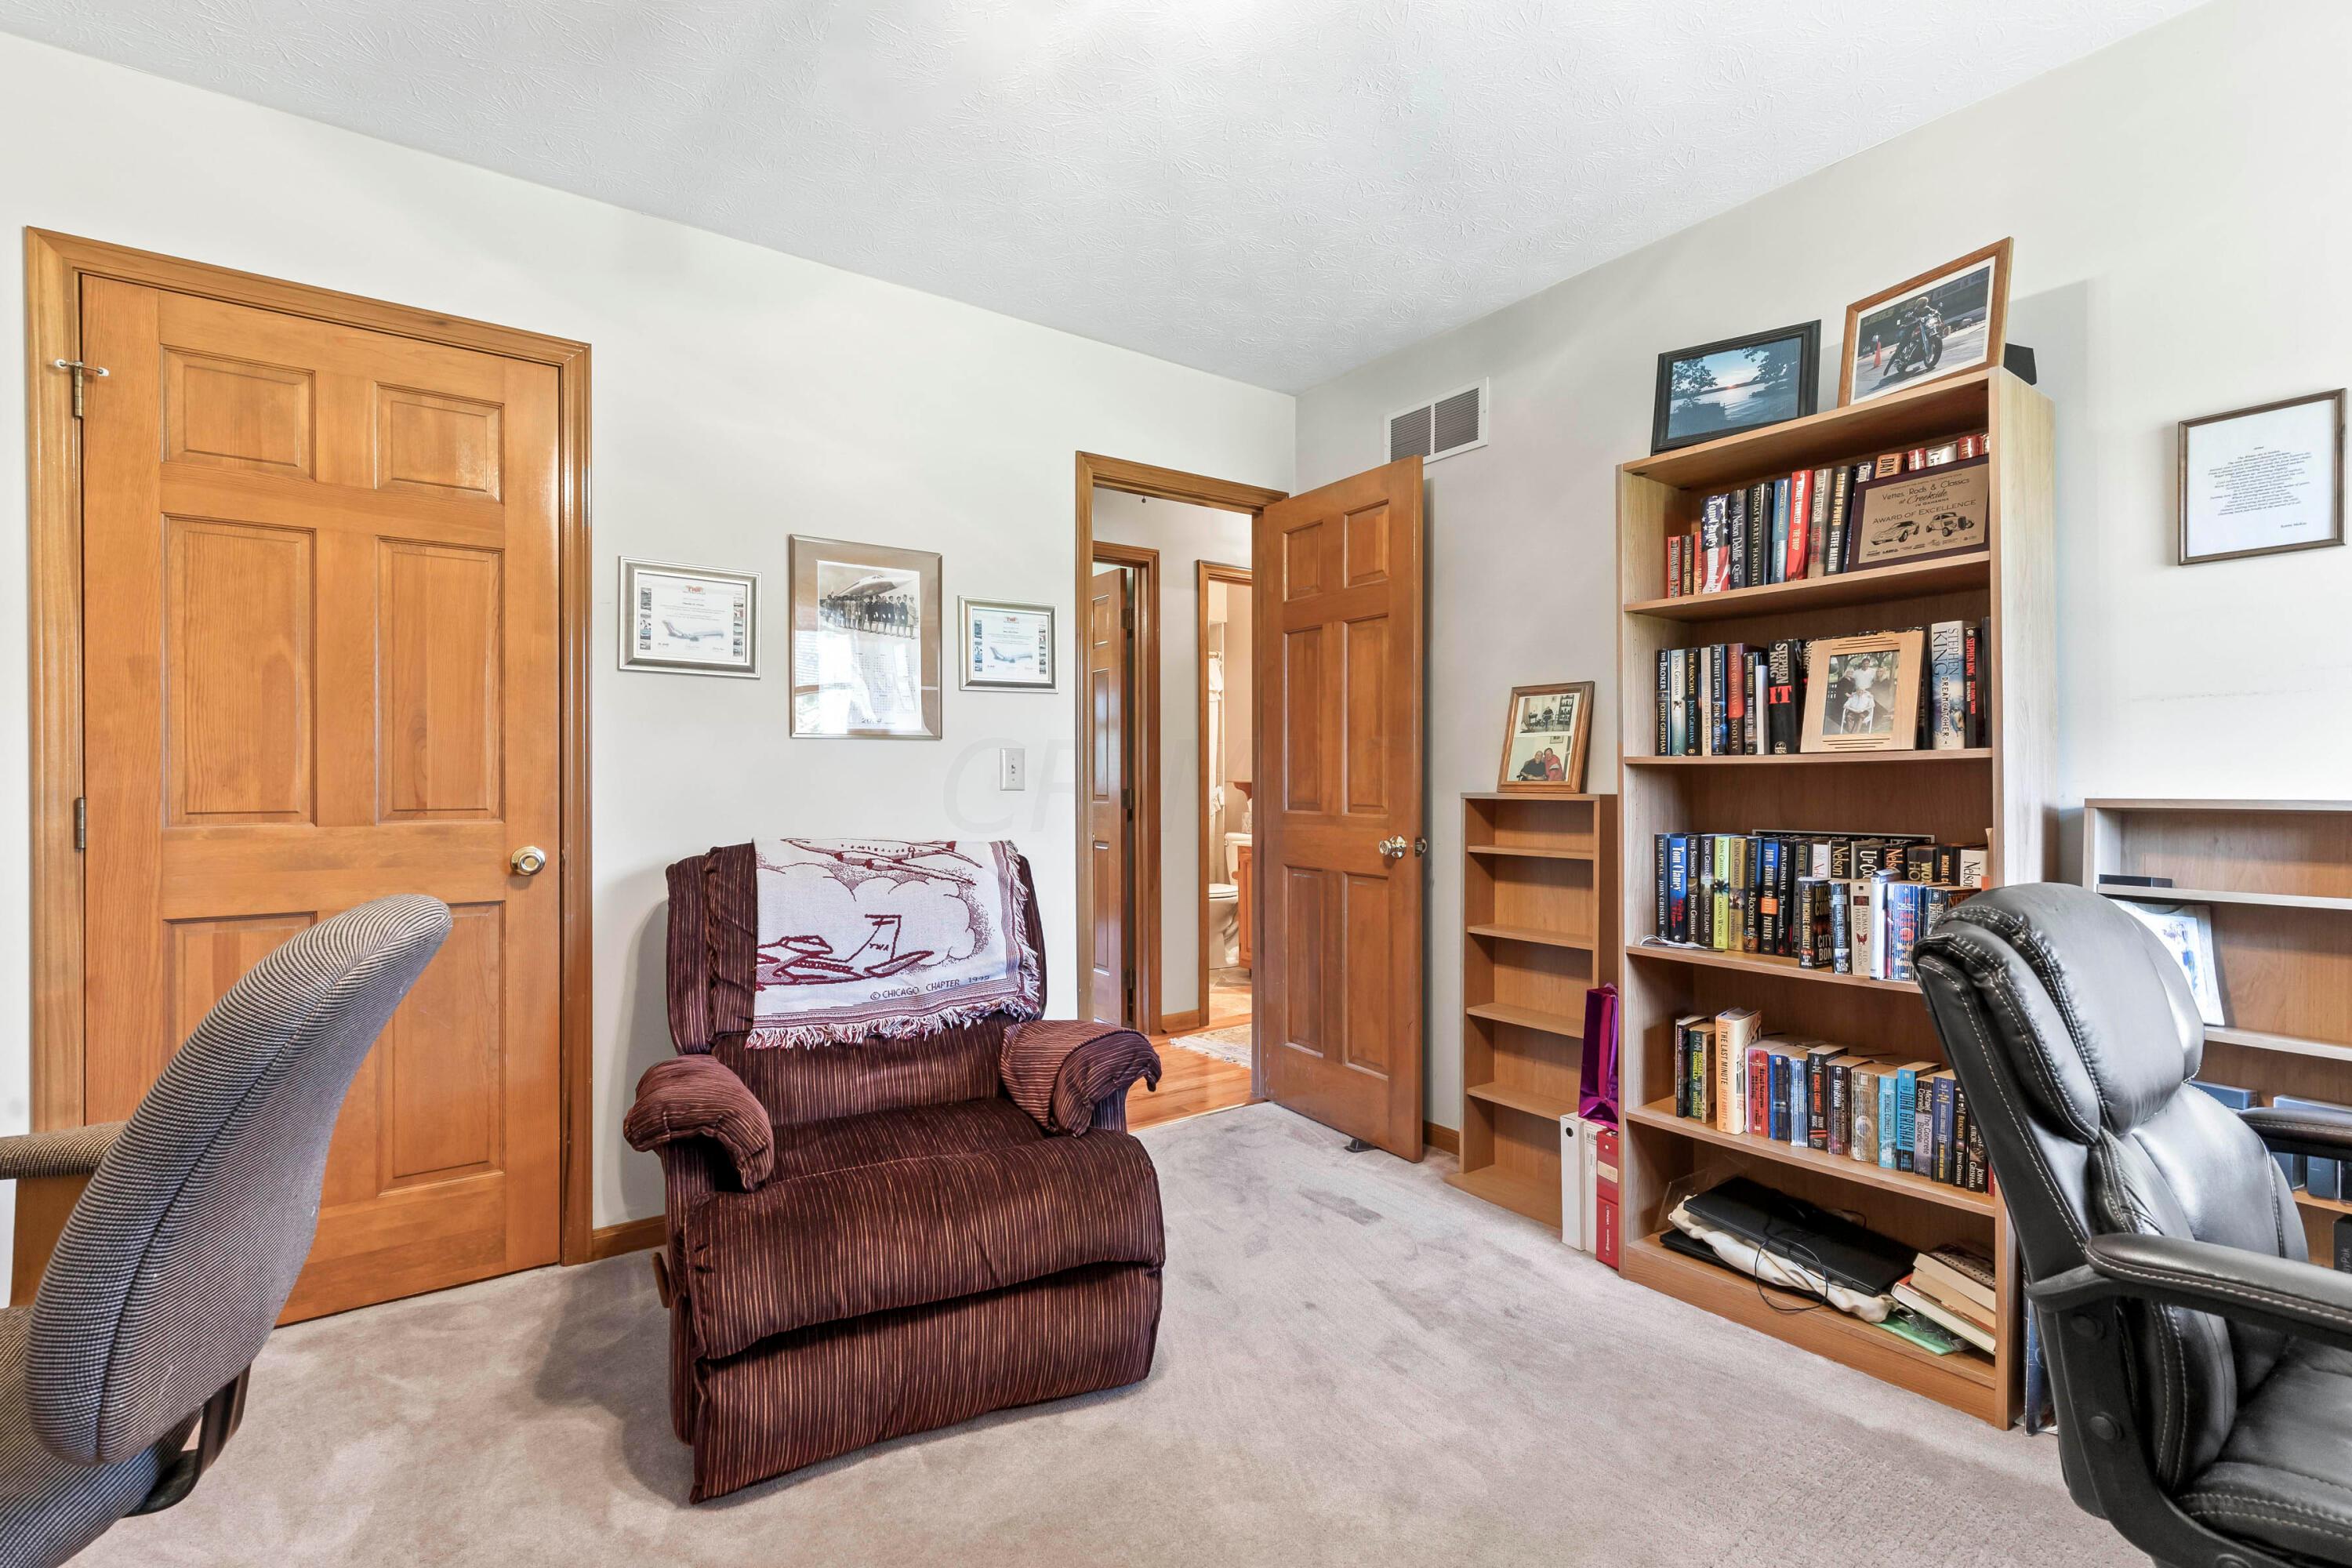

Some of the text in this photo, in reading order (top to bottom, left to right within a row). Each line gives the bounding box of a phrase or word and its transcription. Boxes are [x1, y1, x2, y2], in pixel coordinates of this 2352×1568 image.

[1880, 458, 1894, 474] DAN
[1795, 480, 1805, 500] MICHAEL
[1835, 473, 1846, 497] SHADOW
[1882, 492, 1904, 501] Vettes
[1909, 486, 1927, 495] Rods
[1940, 477, 1970, 488] Classics
[1907, 489, 1947, 504] Creekside
[1813, 474, 1825, 522] JAMES PATTERSON
[1794, 501, 1802, 524] CONNELLY
[1833, 506, 1842, 526] POWER
[1873, 514, 1902, 524] AWARD
[1918, 499, 1976, 515] EXCELLENCE
[1733, 514, 1742, 536] Nelson
[1733, 537, 1742, 561] DeMille
[1831, 531, 1840, 547] STEVE
[1670, 549, 1679, 566] THOMAS
[1828, 547, 1838, 572] MARTINI
[1933, 630, 1948, 676] KING
[1948, 628, 1959, 675] STEPHEN
[1966, 638, 1976, 662] STEPHEN
[1769, 652, 1779, 678] KING
[1775, 643, 1788, 684] STEPHEN
[1966, 662, 1976, 676] KING
[1769, 685, 1793, 704] IT
[1712, 701, 1721, 717] JOHN
[1670, 847, 1685, 891] Tom Clancy
[1833, 847, 1849, 876] Nelson
[1860, 851, 1877, 863] UP
[1941, 855, 1950, 876] MICHAEL
[1763, 849, 1773, 940] JOHN GRISHAM PARTNERS
[1748, 897, 1756, 925] ROOSTER
[869, 942, 890, 952] TWA
[1818, 935, 1831, 947] CITY
[882, 986, 920, 999] CHICAGO
[925, 979, 960, 992] CHAPTER
[1916, 1088, 1926, 1112] Connelly
[1900, 1091, 1915, 1148] JOHN GRISHAM
